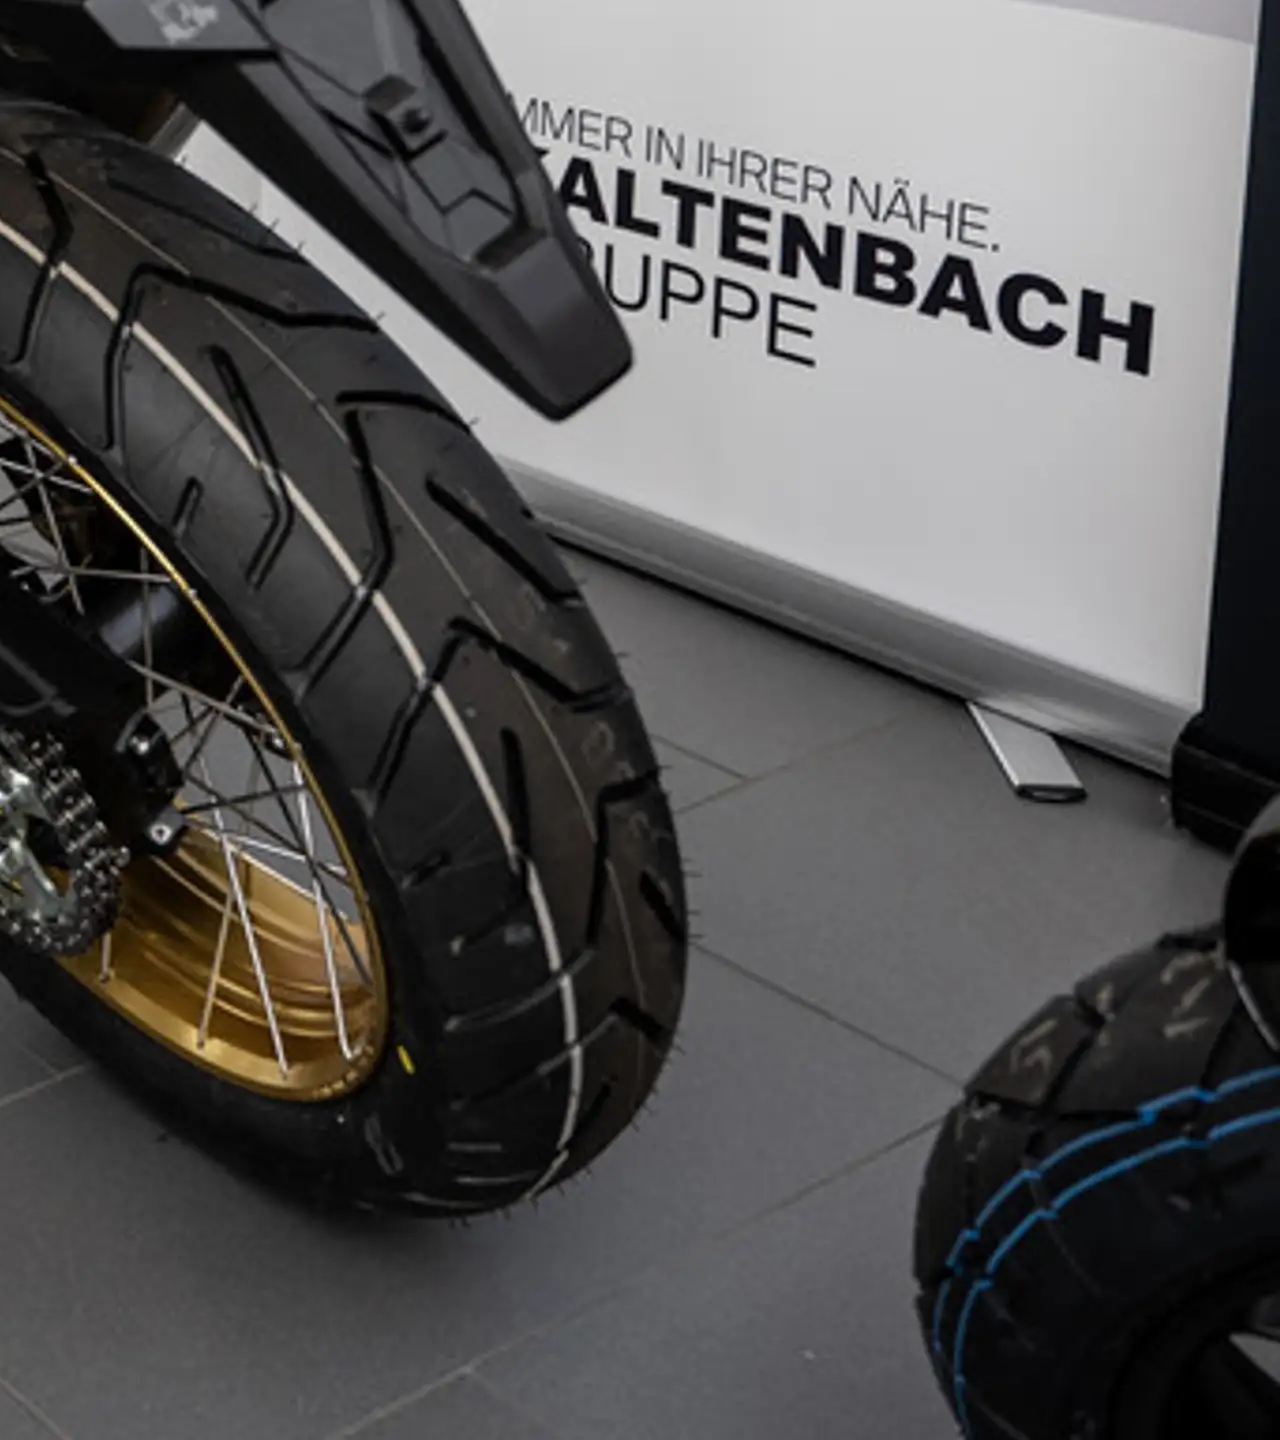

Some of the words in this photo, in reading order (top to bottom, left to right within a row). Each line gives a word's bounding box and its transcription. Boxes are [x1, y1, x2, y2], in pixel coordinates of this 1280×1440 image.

[536, 147, 1155, 377] ALTENBACH
[645, 125, 686, 170] IN
[697, 141, 834, 211] IHRER
[847, 175, 1001, 253] NÄHE.
